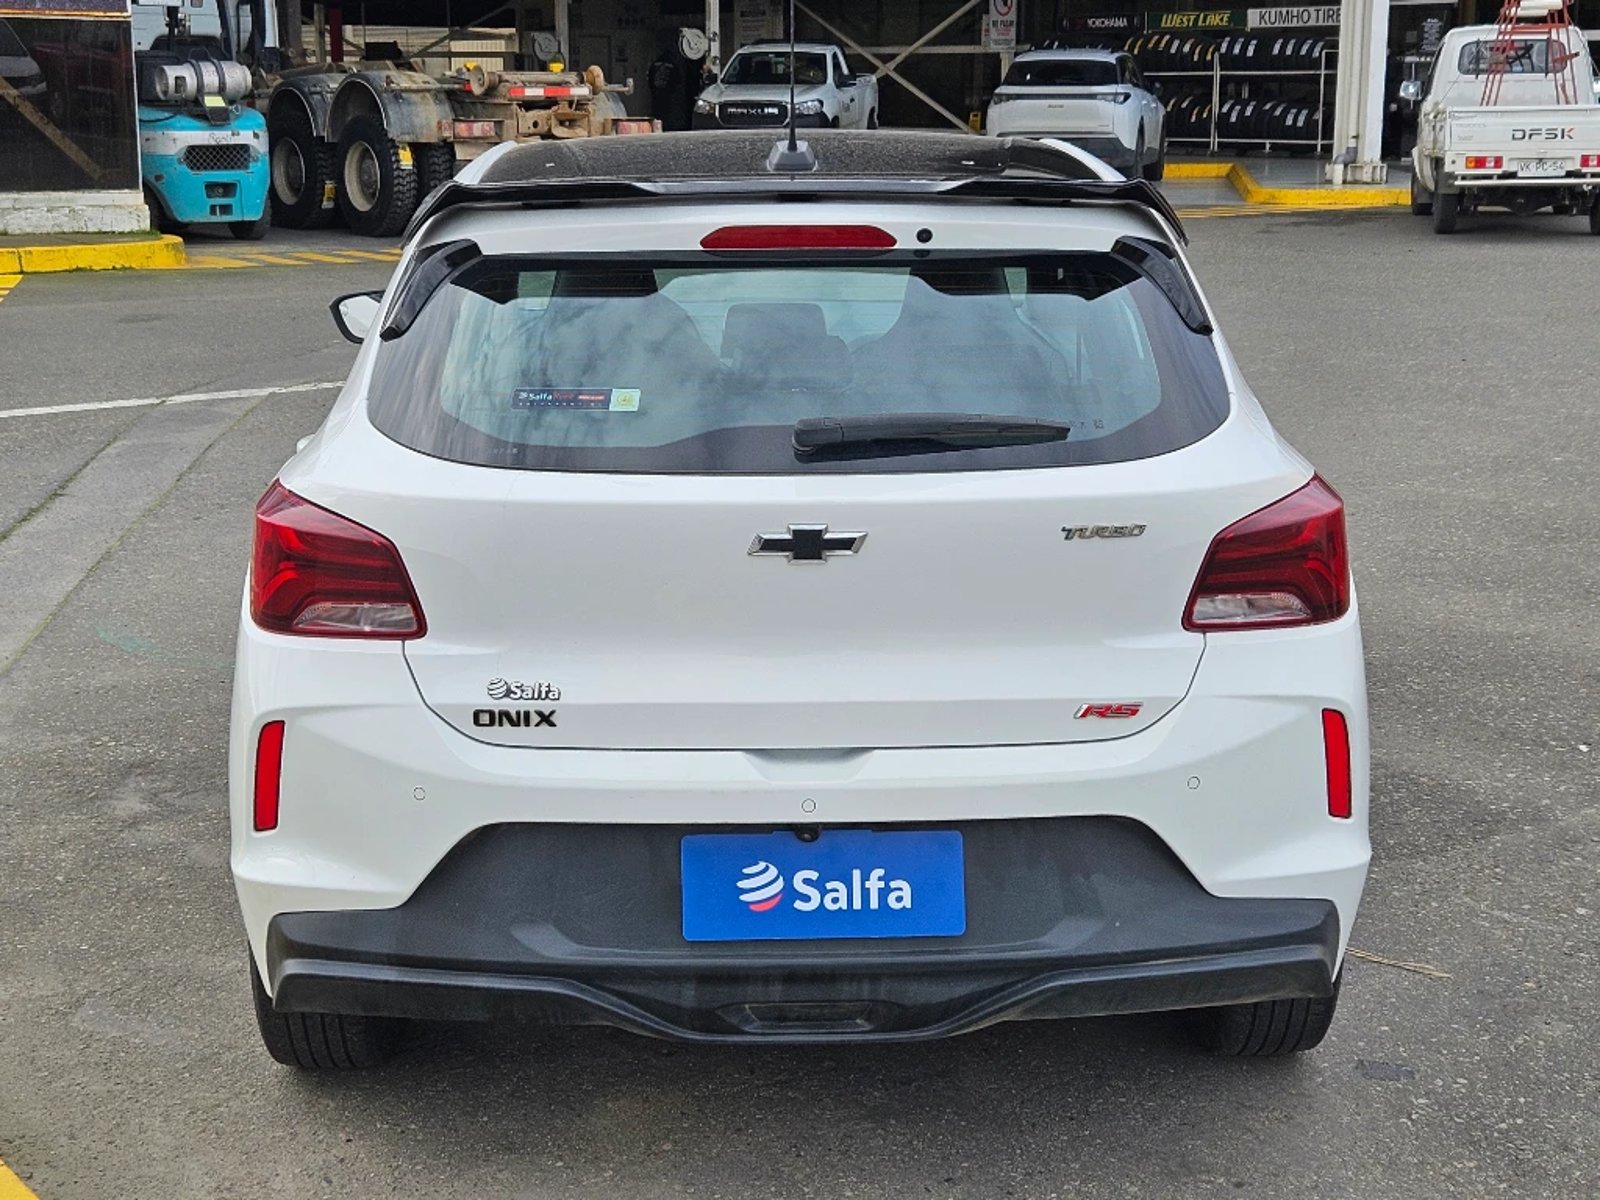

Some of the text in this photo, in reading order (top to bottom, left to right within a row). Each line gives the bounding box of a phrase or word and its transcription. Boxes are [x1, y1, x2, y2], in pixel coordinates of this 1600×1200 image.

[1087, 17, 1128, 27] YOKOHAMA
[1160, 10, 1231, 28] WEST LAKE
[1258, 9, 1311, 26] KUMHO
[1511, 127, 1575, 141] DFSK
[1061, 524, 1147, 541] TURBO
[508, 681, 561, 701] Salfa
[473, 709, 557, 727] ONIX
[1073, 702, 1144, 719] RS
[792, 868, 912, 912] Salfa
